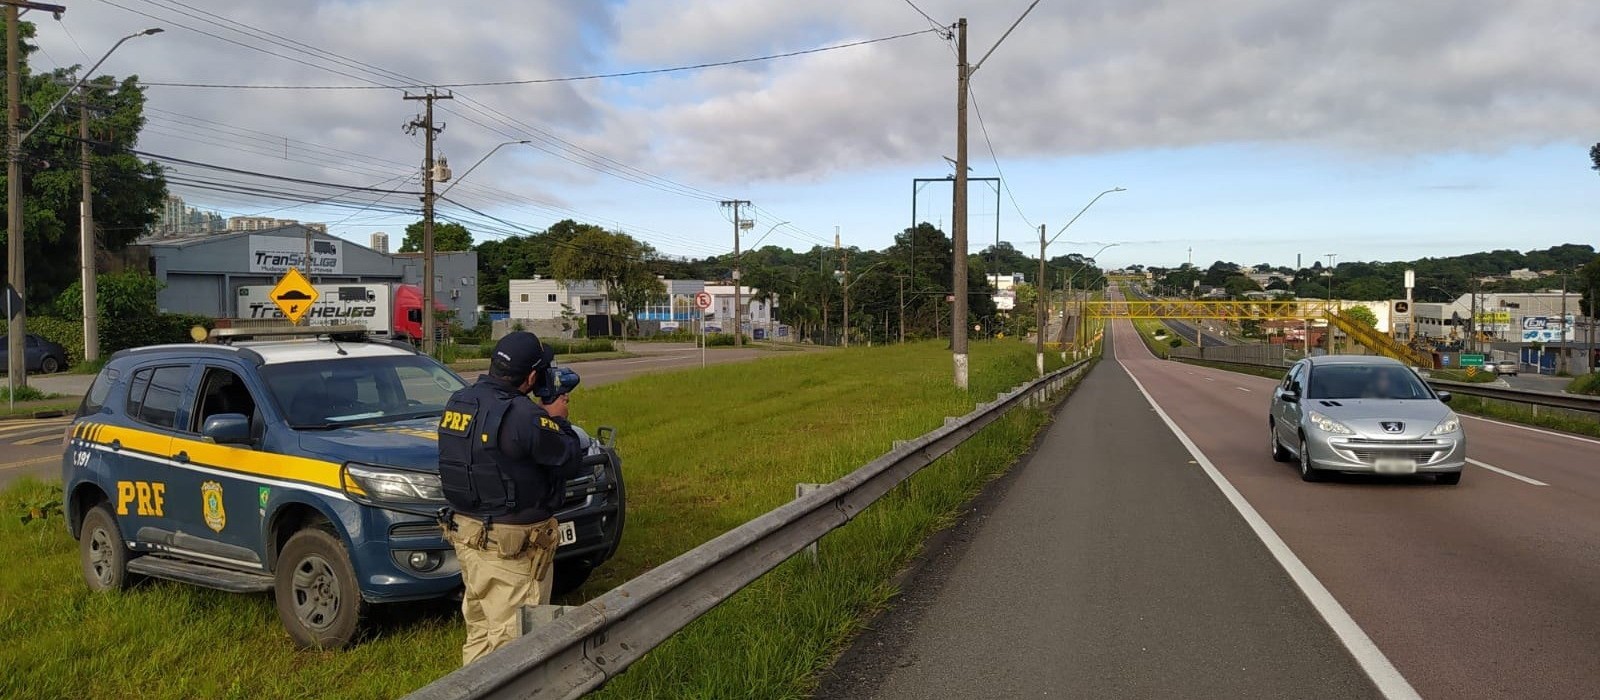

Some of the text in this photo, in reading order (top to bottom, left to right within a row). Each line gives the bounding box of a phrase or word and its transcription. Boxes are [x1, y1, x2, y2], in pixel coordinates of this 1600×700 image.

[440, 410, 473, 431] PRF
[76, 451, 91, 467] 191
[116, 480, 165, 517] PRF
[561, 528, 573, 543] 18
